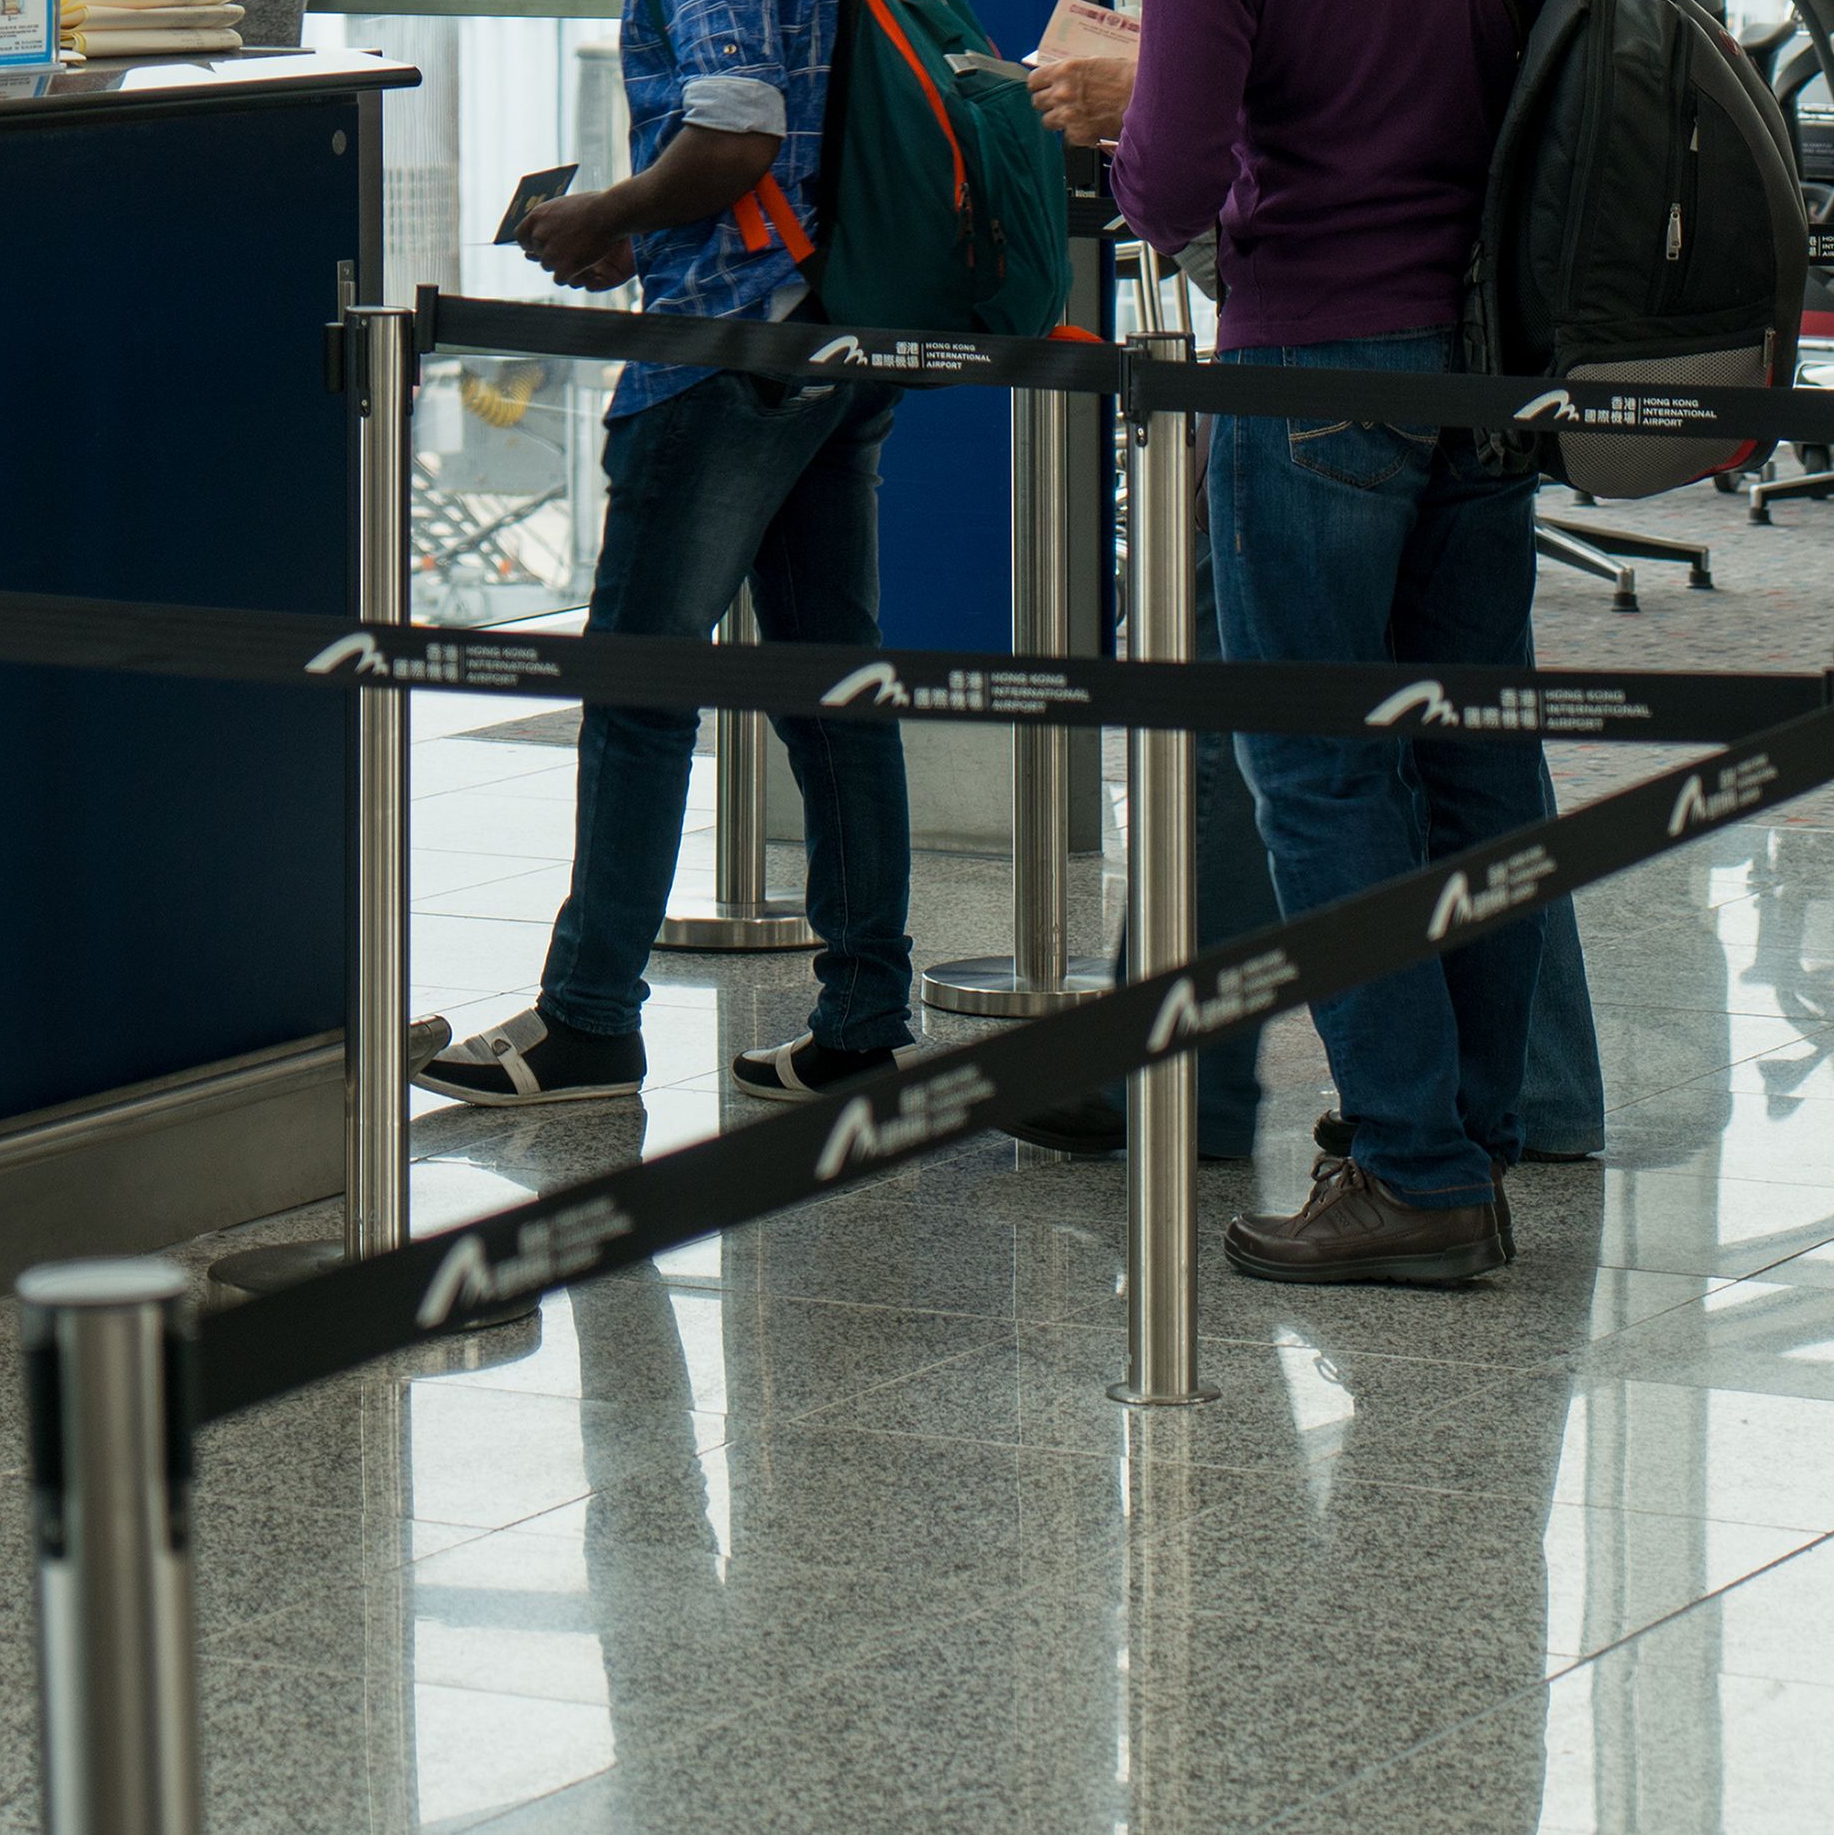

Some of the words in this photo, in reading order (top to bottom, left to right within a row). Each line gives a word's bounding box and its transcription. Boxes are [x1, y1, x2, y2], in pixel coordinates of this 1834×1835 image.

[926, 342, 951, 350] HONG
[952, 343, 976, 352] KONG
[927, 351, 991, 363] INTERNATIONAL
[927, 361, 963, 370] AIRPORT
[1611, 396, 1636, 411] 香港
[1643, 398, 1670, 407] HONG
[1672, 399, 1699, 408] KONG
[1643, 408, 1717, 419] INTERNATIONAL
[1643, 418, 1683, 427] AIRPORT
